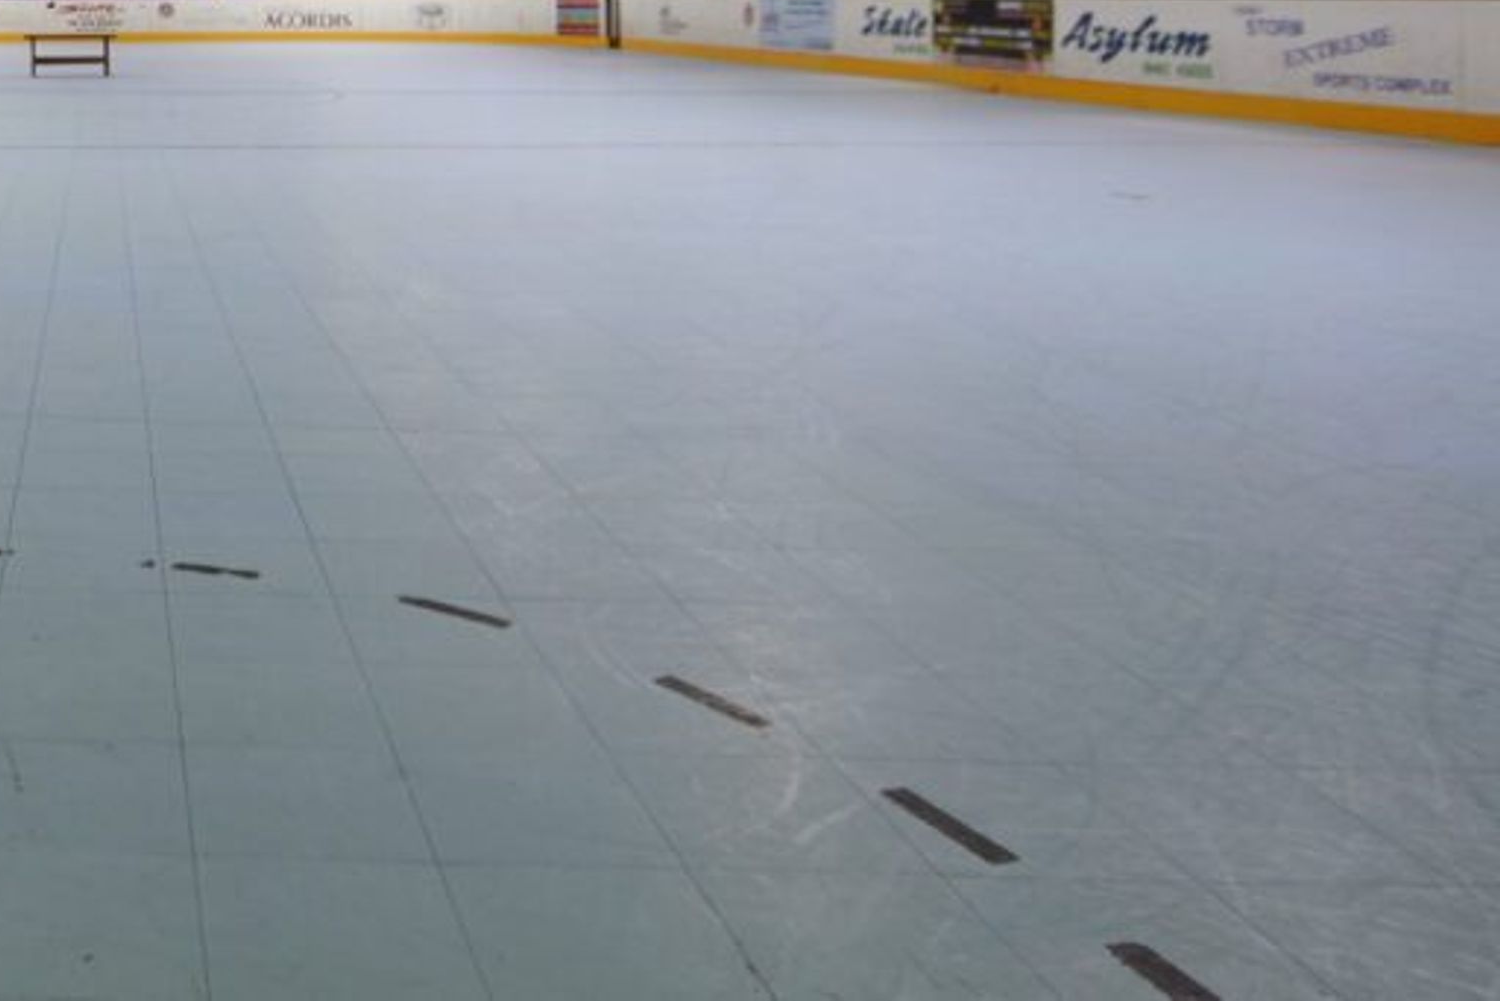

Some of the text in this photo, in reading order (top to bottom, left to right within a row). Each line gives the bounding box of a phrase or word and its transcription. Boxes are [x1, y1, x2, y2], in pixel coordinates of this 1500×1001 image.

[263, 11, 353, 30] ACORDIS
[860, 6, 928, 38] Skate
[1061, 10, 1211, 64] Asylum
[1283, 25, 1397, 69] EXTREME
